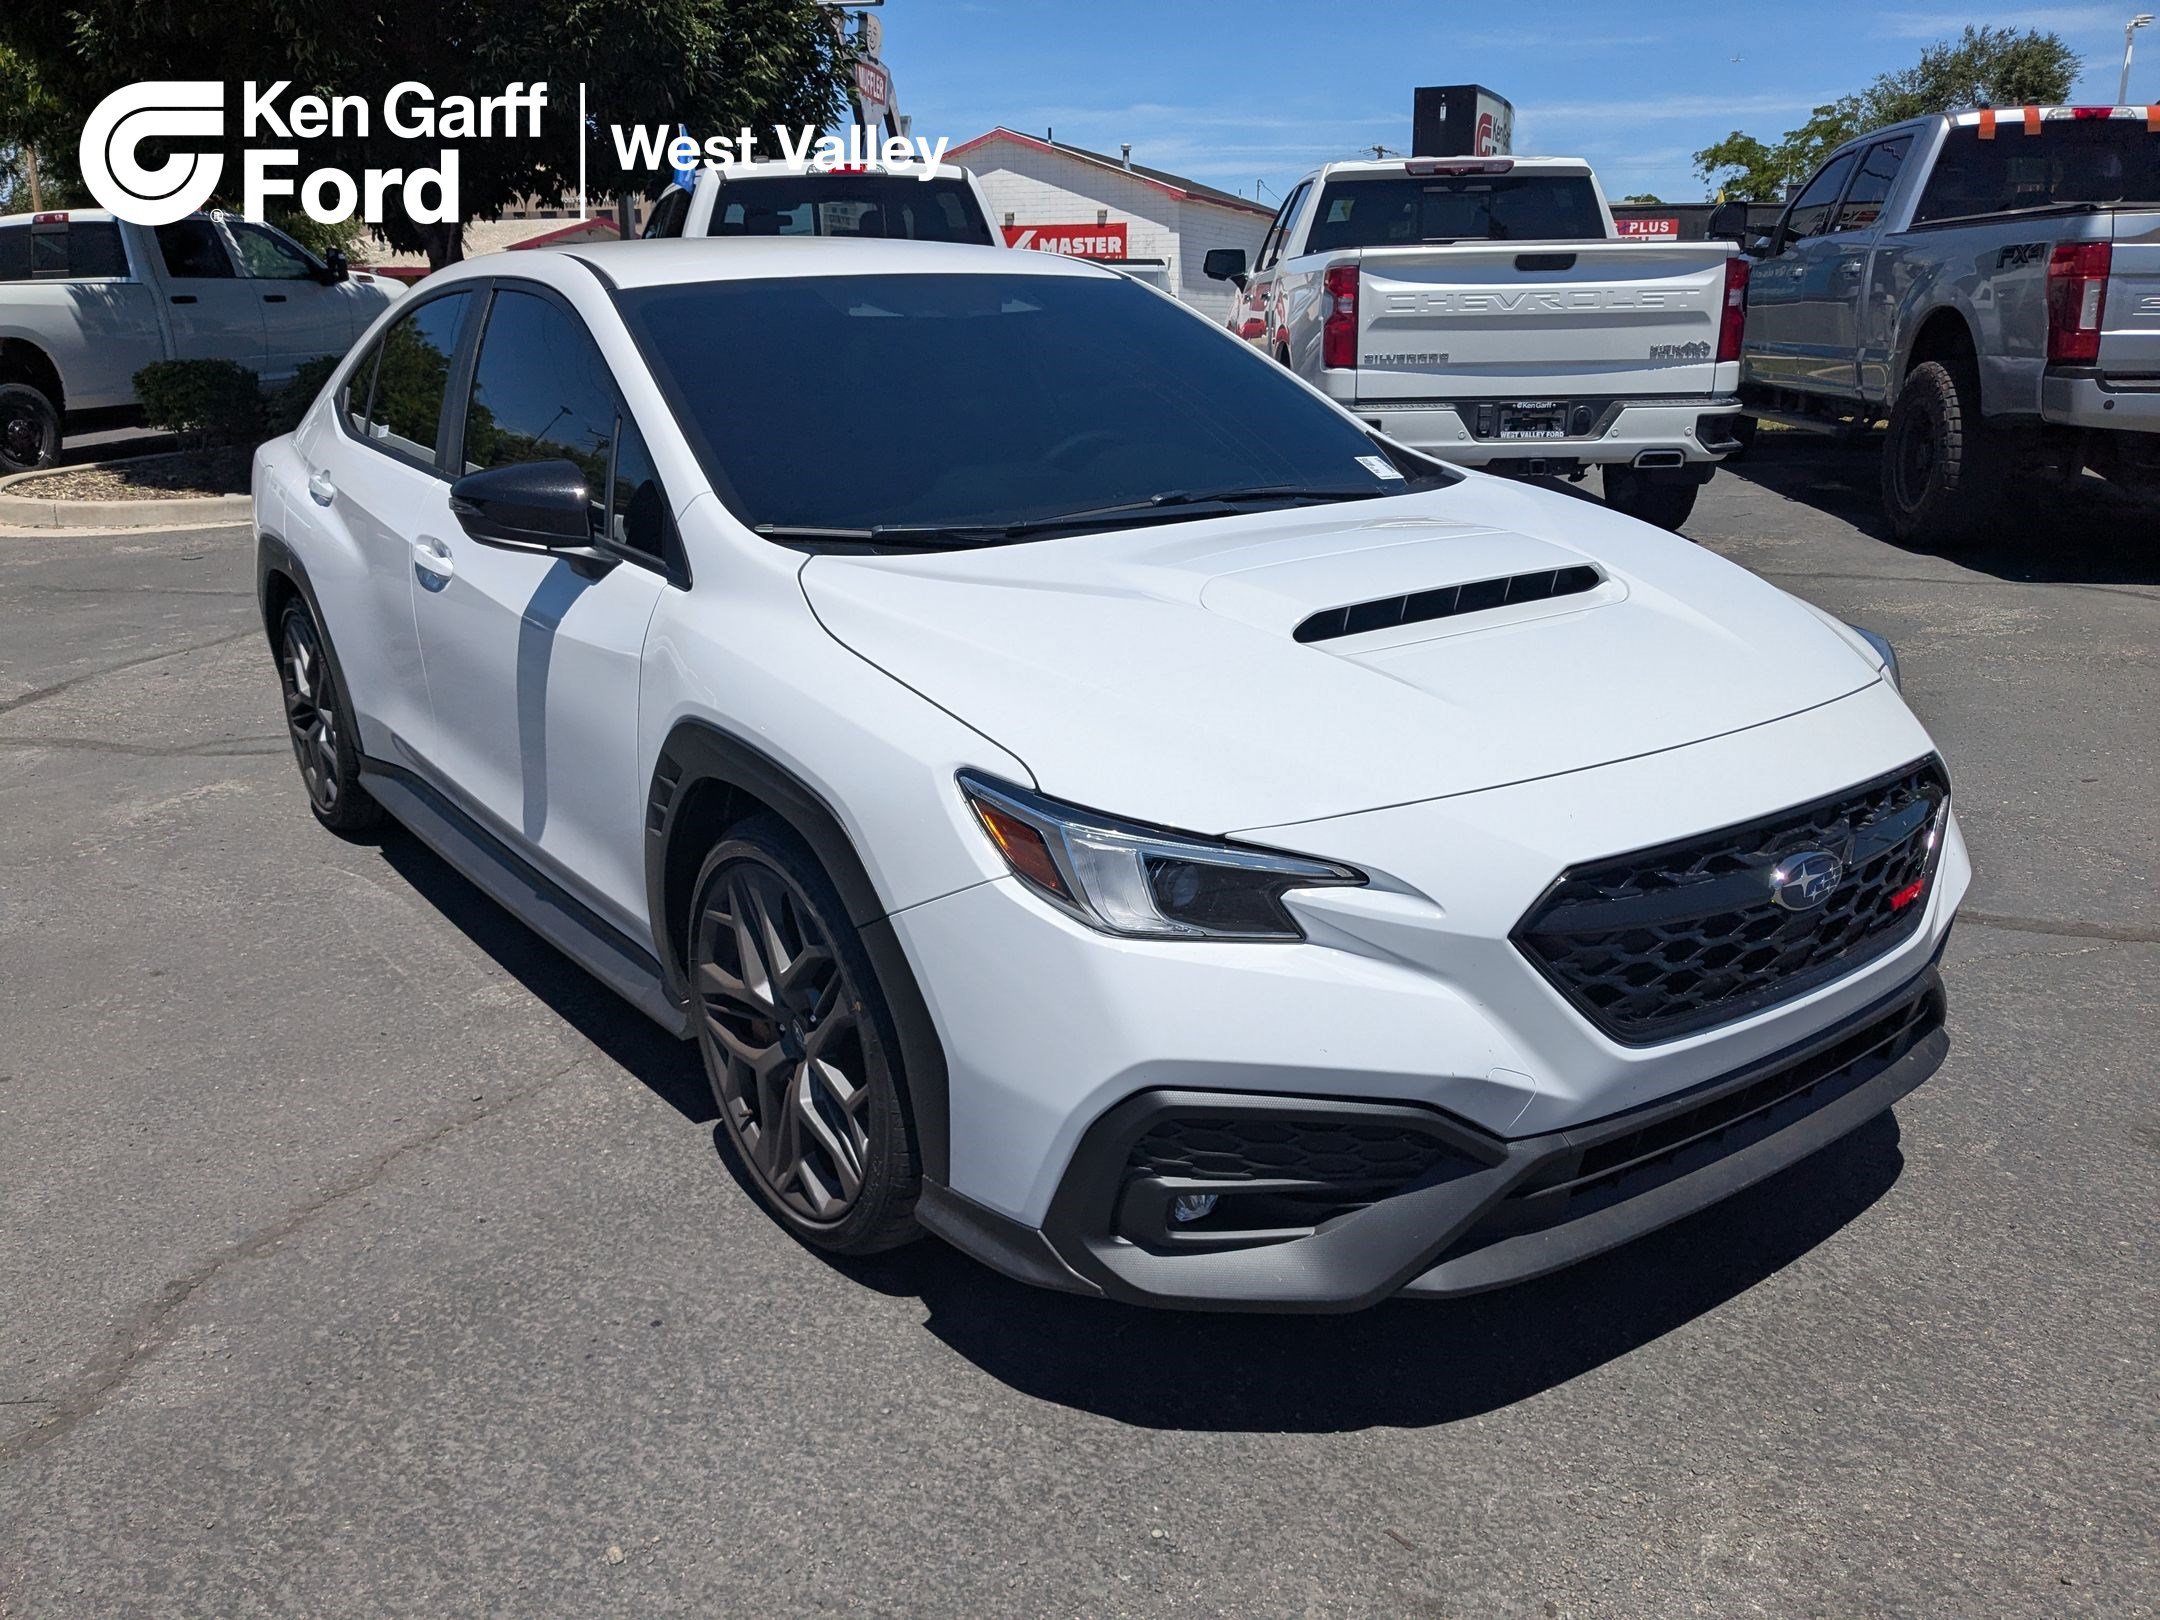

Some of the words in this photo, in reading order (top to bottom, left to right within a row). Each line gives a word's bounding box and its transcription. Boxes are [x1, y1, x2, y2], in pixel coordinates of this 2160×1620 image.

[1629, 221, 1670, 234] PLUS
[1039, 236, 1122, 254] MASTER
[1996, 243, 2046, 268] FX4
[1385, 289, 1701, 313] CHEVROLET
[1500, 431, 1520, 439] WEST
[1520, 430, 1546, 438] VALLEY
